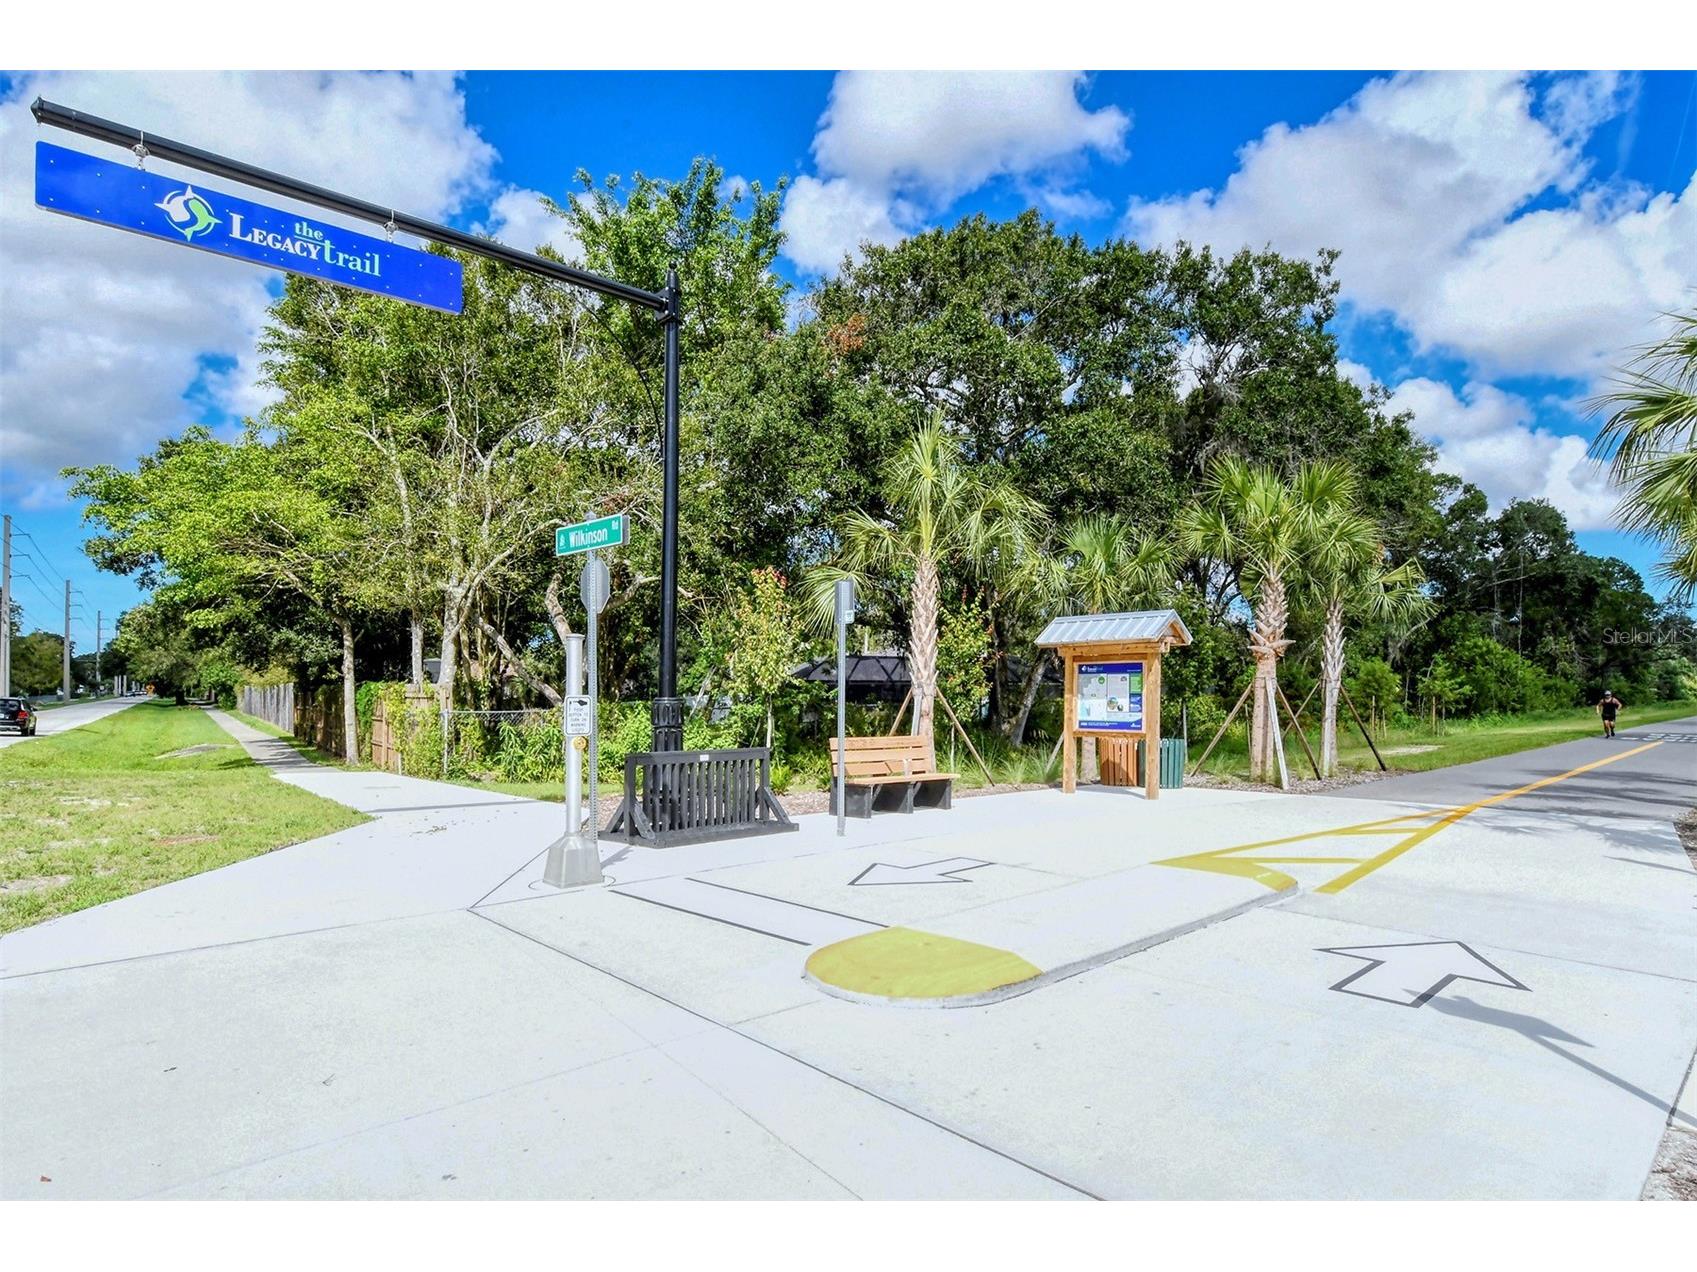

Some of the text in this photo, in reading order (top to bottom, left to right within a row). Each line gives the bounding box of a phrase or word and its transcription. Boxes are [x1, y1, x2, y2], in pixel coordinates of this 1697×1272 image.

[294, 222, 324, 241] the
[229, 212, 381, 277] LEGACY trail
[569, 528, 608, 548] Wilkinson
